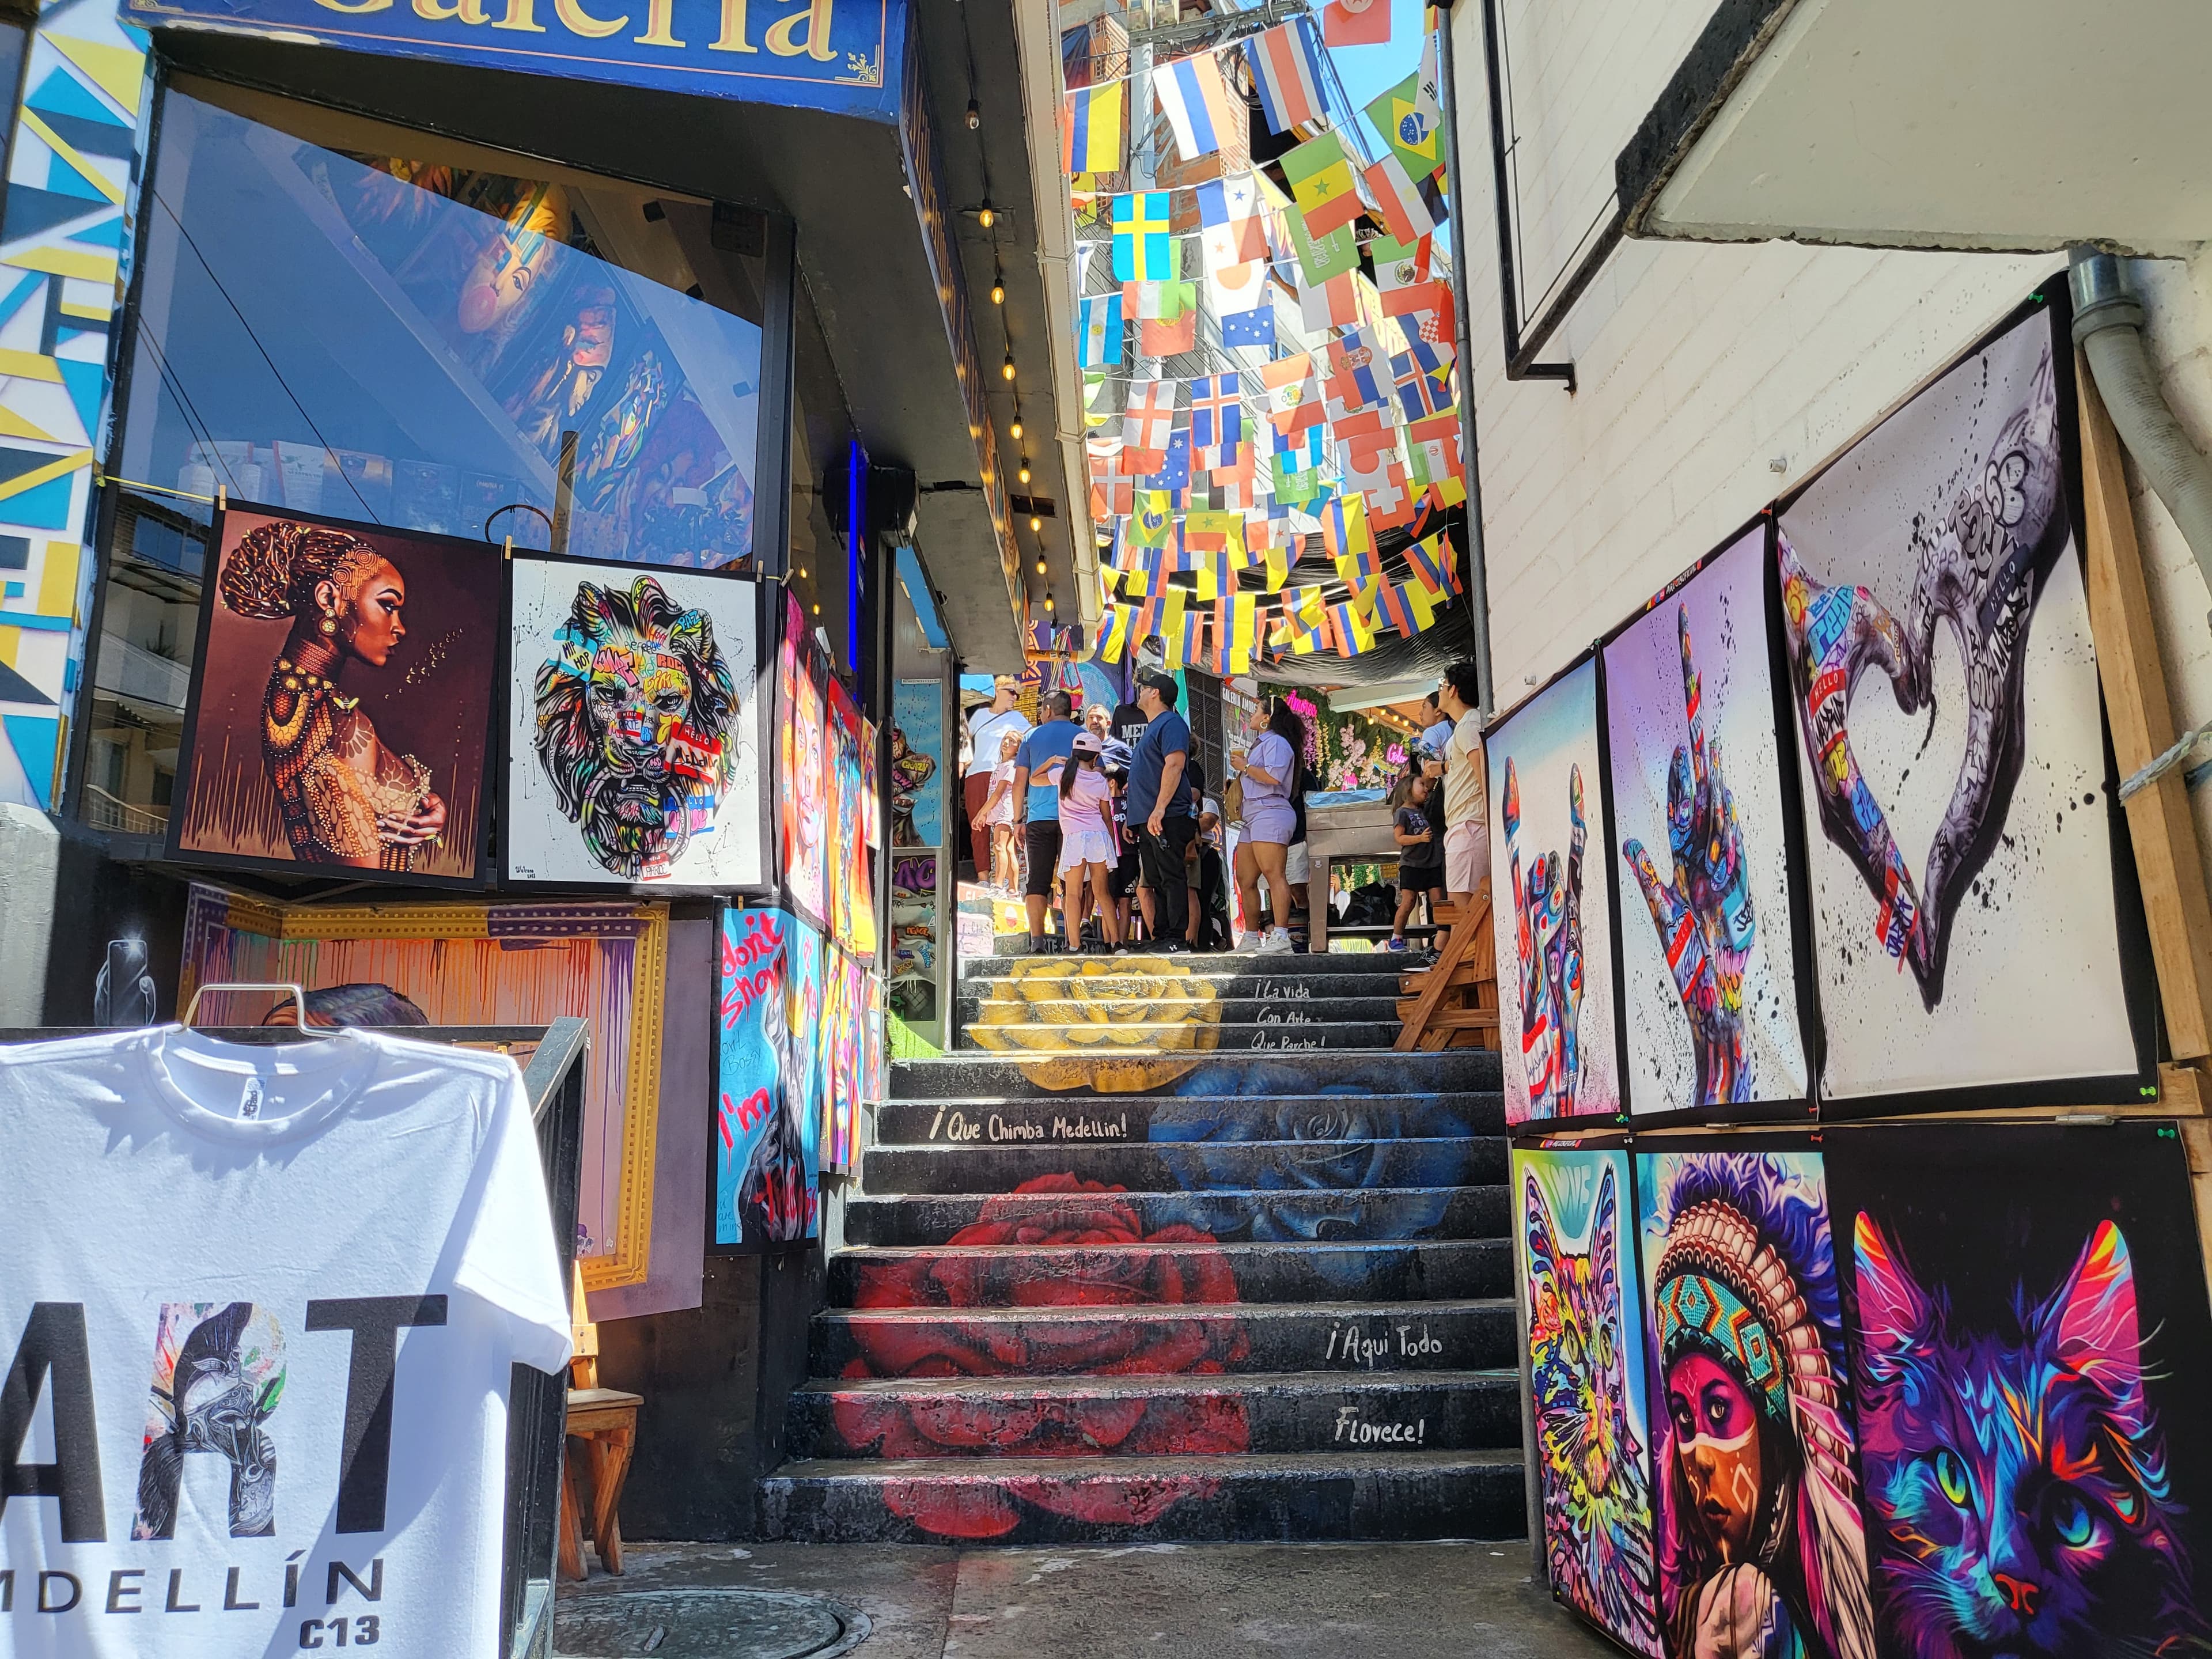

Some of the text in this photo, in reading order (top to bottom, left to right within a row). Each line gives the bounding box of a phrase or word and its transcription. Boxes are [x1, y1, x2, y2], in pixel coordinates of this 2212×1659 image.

[1990, 560, 2016, 613] HELLO
[562, 641, 577, 659] HIP
[573, 652, 590, 671] HOP
[657, 654, 690, 677] ROCK
[1815, 676, 1839, 701] HELLO
[684, 728, 710, 745] HELLO
[1257, 1006, 1311, 1024] Con Arte
[1251, 1030, 1276, 1049] Que
[988, 1114, 1044, 1142] Chimba
[1052, 1112, 1127, 1139] Medellin!
[1396, 1323, 1442, 1357] Todo
[0, 1294, 449, 1543] ART
[299, 1615, 380, 1649] C13
